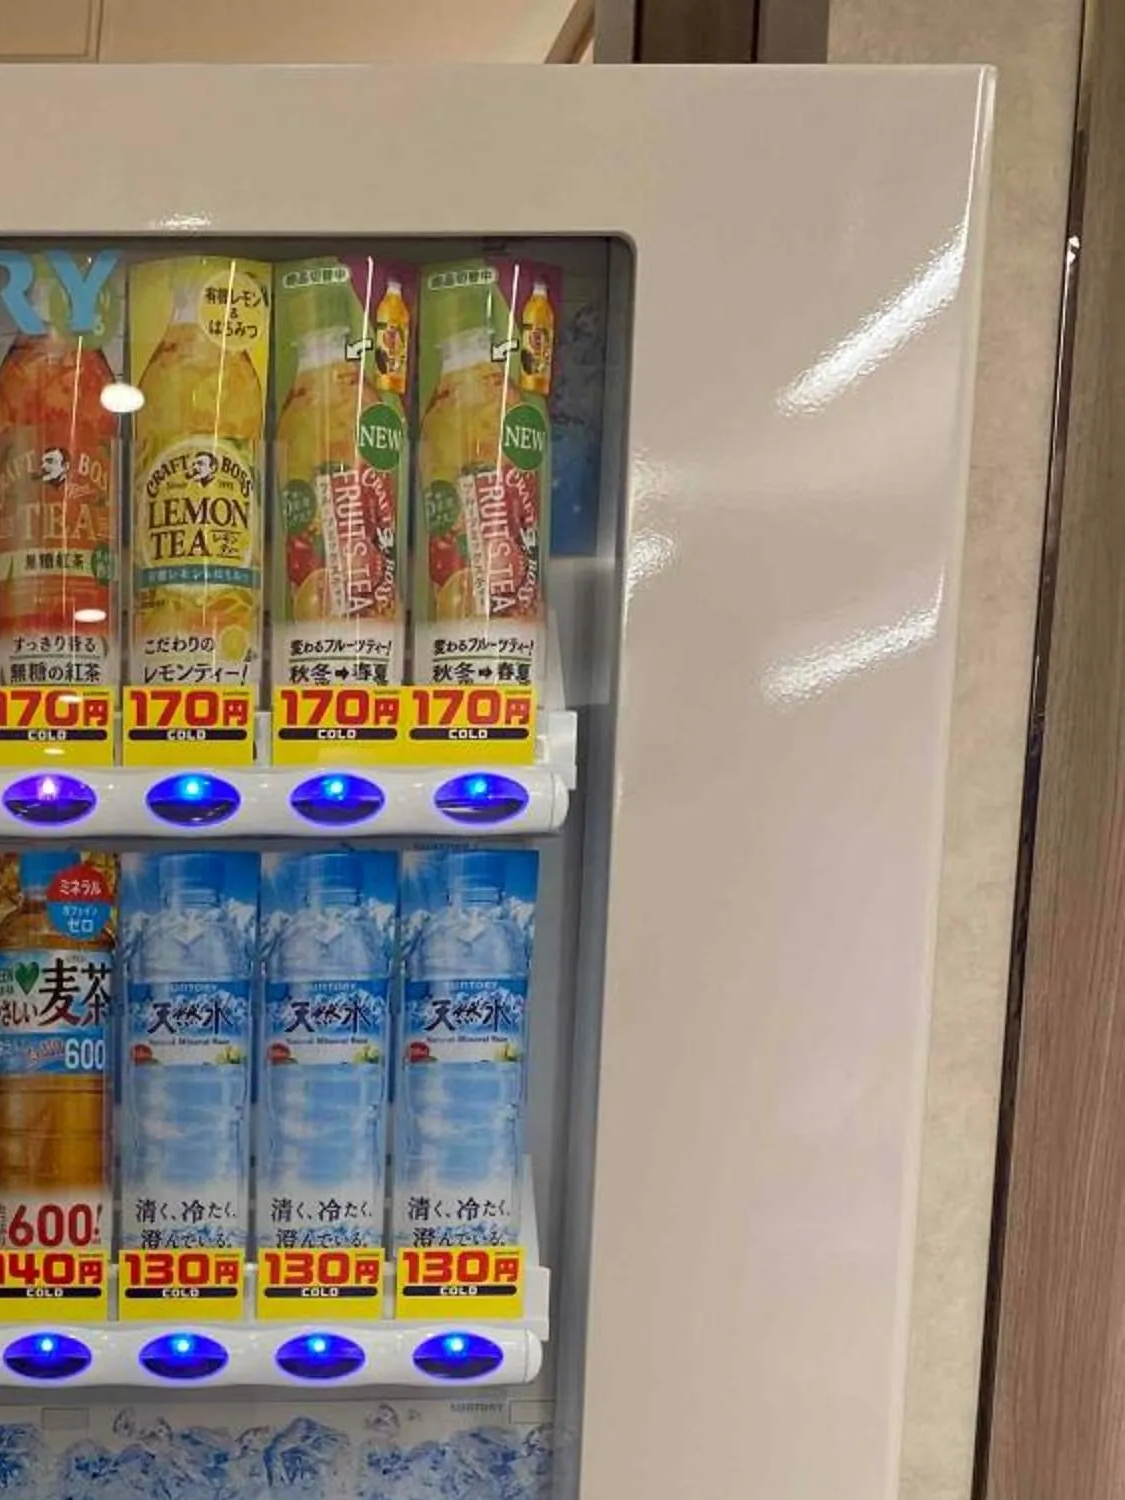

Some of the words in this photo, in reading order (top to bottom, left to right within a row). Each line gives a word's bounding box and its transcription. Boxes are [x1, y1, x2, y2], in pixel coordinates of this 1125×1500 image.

[208, 320, 258, 339] はちみつ
[360, 426, 401, 450] NEW
[505, 426, 546, 450] NEW
[146, 454, 190, 498] CRAFT
[17, 502, 96, 541] TEA
[148, 497, 249, 529] LEMON
[332, 470, 368, 556] FRUITS
[476, 471, 511, 558] FRUITS
[150, 527, 212, 561] TEA
[347, 562, 375, 616] TEA
[488, 560, 517, 613] TEA
[13, 637, 96, 653] すっきり香る
[144, 637, 214, 654] こだわりの
[10, 662, 101, 683] 無糖の紅茶
[143, 662, 249, 686] レモンティー!
[289, 664, 332, 683] 秋冬
[432, 663, 475, 681] 秋冬
[130, 690, 249, 727] 170円
[281, 689, 400, 726] 170円
[412, 689, 531, 726] 170円
[27, 730, 67, 741] COLD
[167, 730, 206, 741] COLD
[317, 729, 357, 739] COLD
[448, 729, 488, 739] COLD
[58, 879, 102, 897] ミネラル
[67, 916, 95, 933] ゼロ
[37, 958, 112, 1027] 麦茶
[146, 999, 234, 1035] 天然水
[284, 998, 372, 1034] 天然水
[425, 998, 512, 1033] 天然水
[64, 1038, 106, 1070] 600
[8, 1202, 103, 1248] 600!
[125, 1253, 240, 1286] 130円
[264, 1252, 380, 1285] 130円
[402, 1250, 520, 1284] 130円
[26, 1288, 63, 1297] COLD
[162, 1288, 200, 1297] COLD
[301, 1287, 339, 1297] COLD
[440, 1286, 478, 1295] COLD
